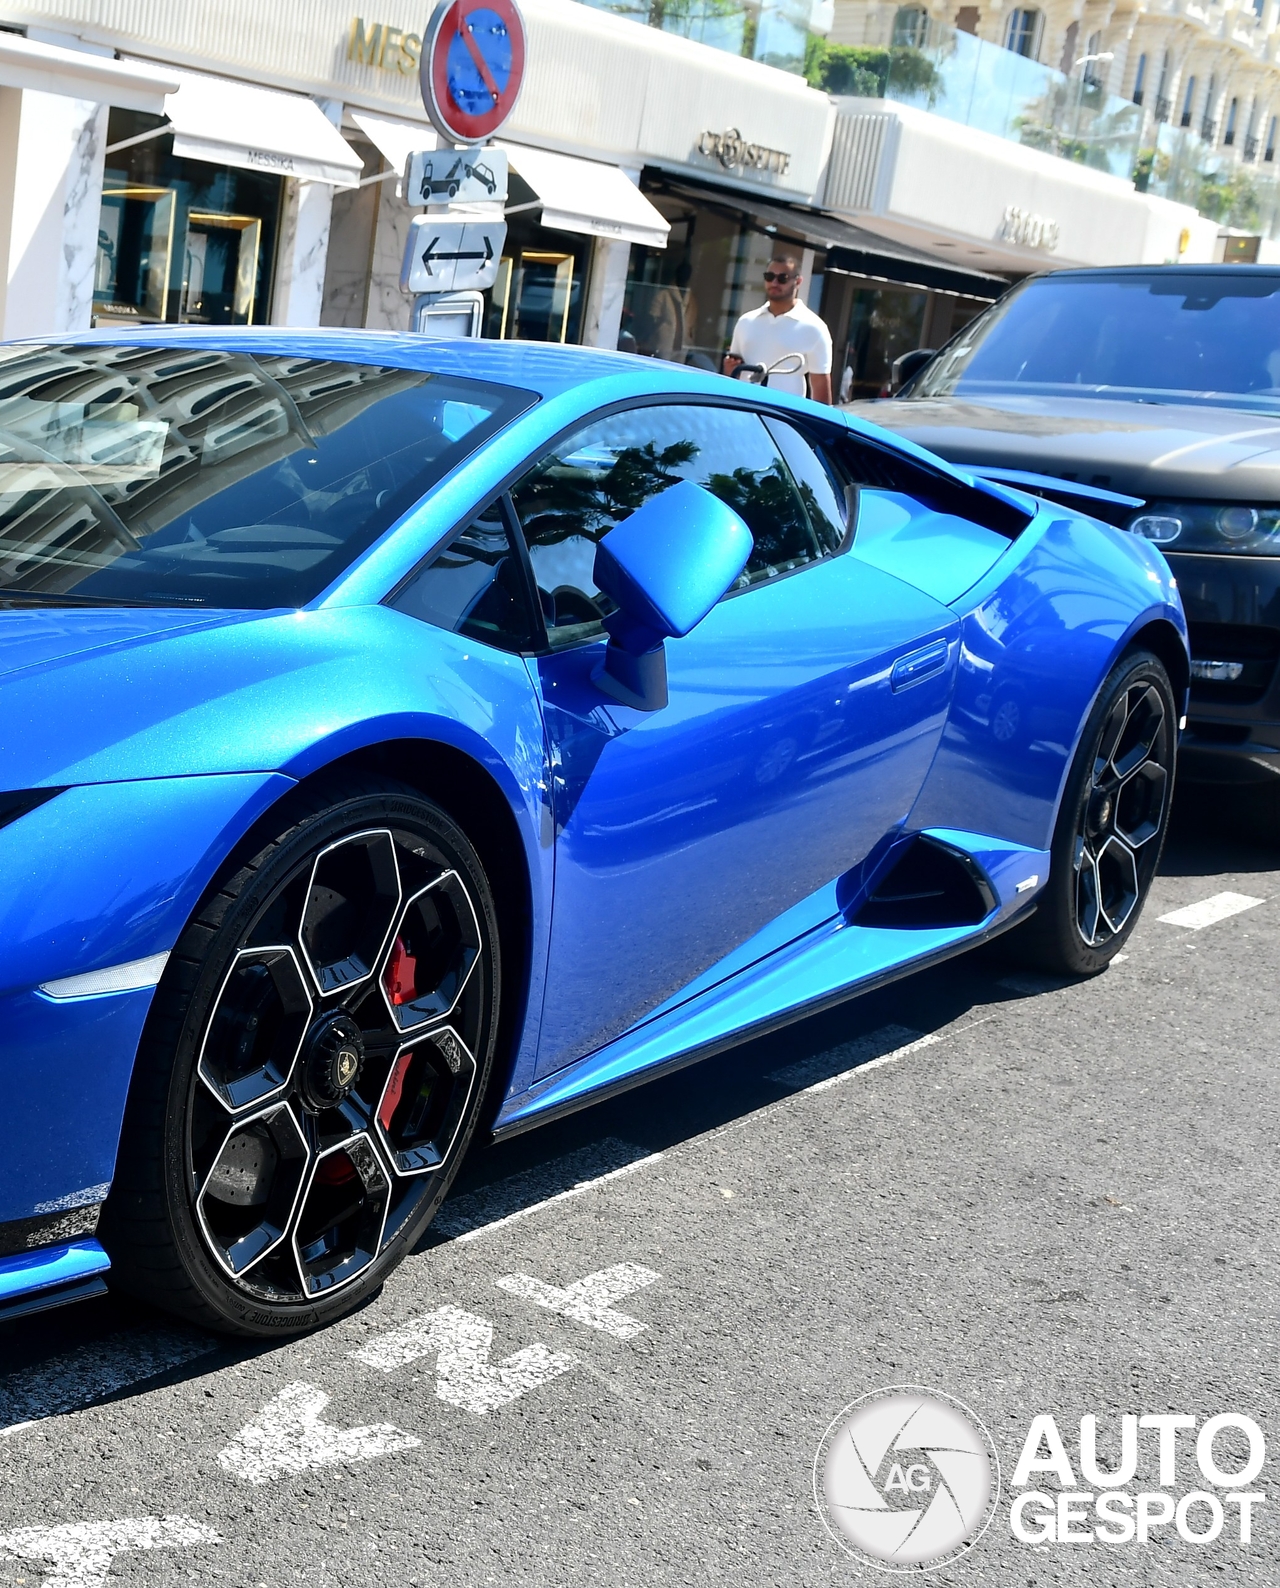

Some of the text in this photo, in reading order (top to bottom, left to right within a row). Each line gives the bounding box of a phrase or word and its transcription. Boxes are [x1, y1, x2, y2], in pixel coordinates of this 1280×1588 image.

[246, 150, 294, 172] MESSIKA
[697, 127, 791, 175] CROISETTE
[390, 799, 445, 828] BRIDGESTONE
[249, 1311, 313, 1328] BRIDGESTONE
